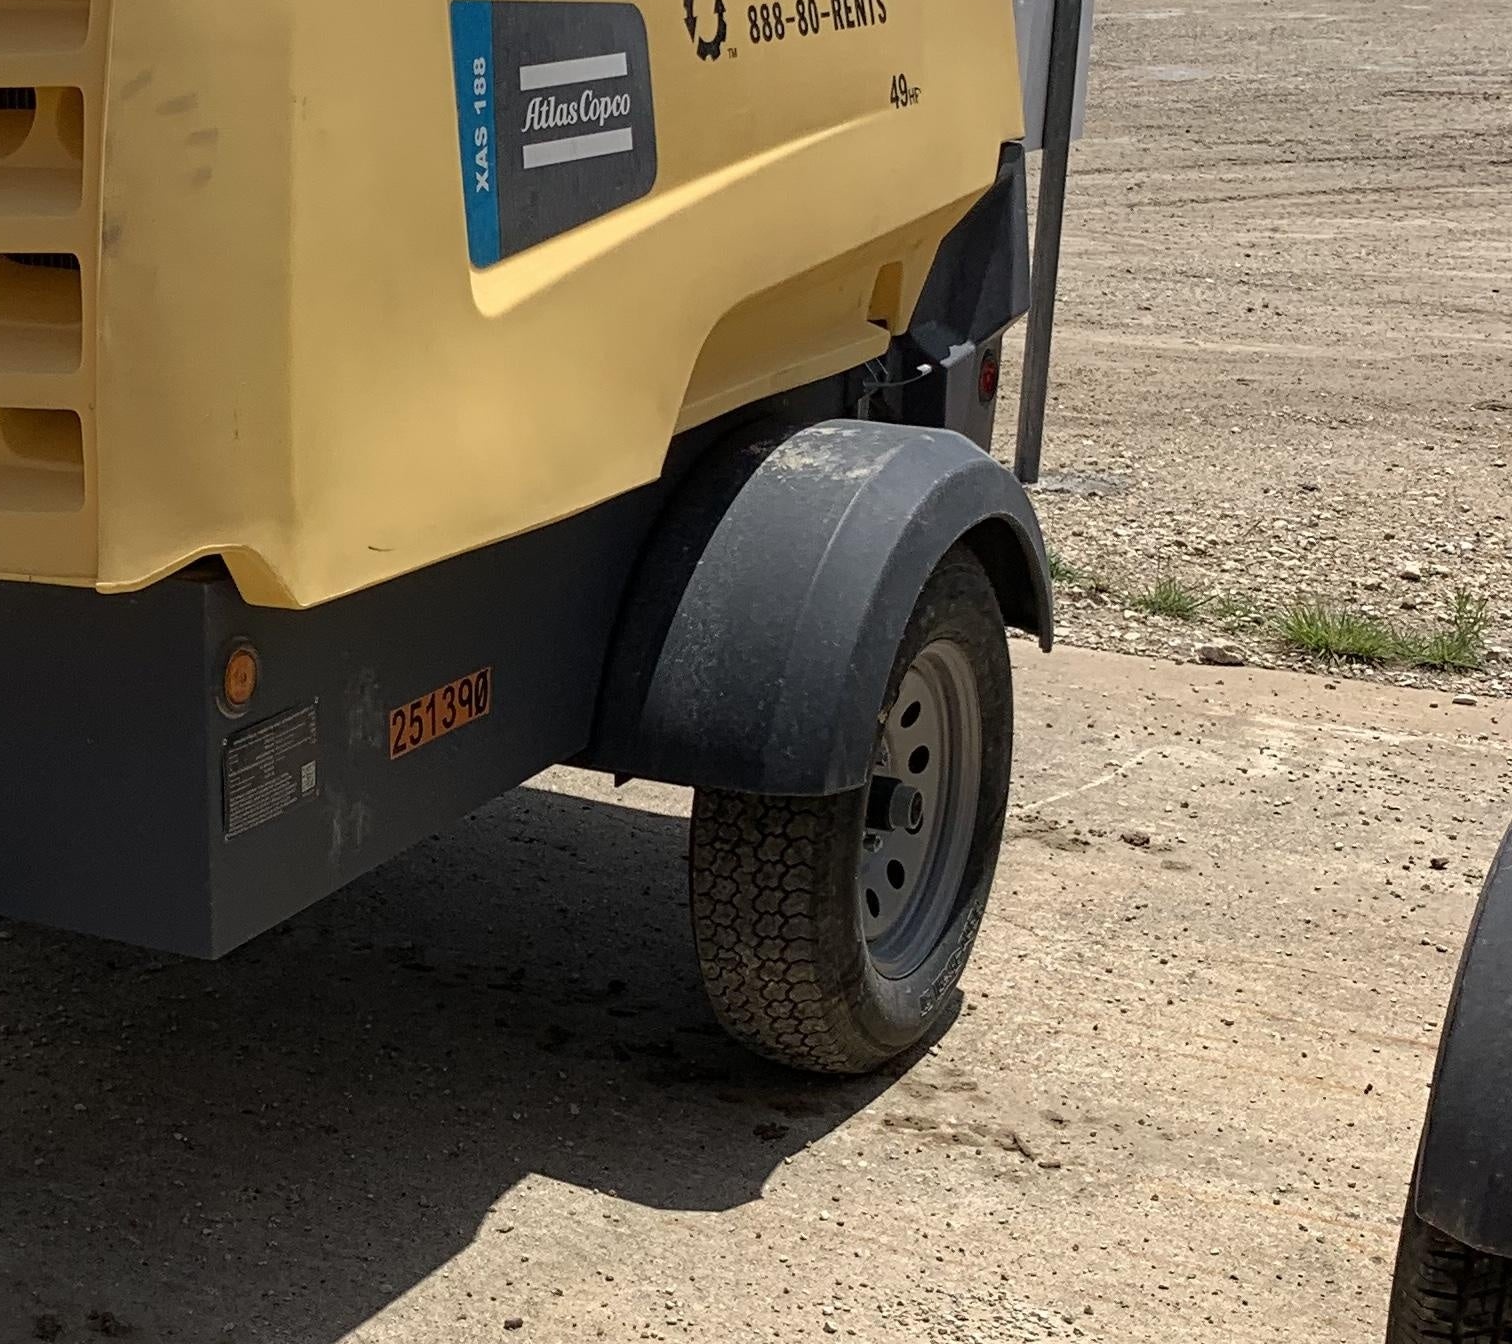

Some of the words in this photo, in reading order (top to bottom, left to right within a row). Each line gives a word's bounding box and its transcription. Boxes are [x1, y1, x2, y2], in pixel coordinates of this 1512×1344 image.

[473, 57, 488, 115] 188
[475, 126, 490, 193] XAS
[392, 669, 489, 756] 251390
